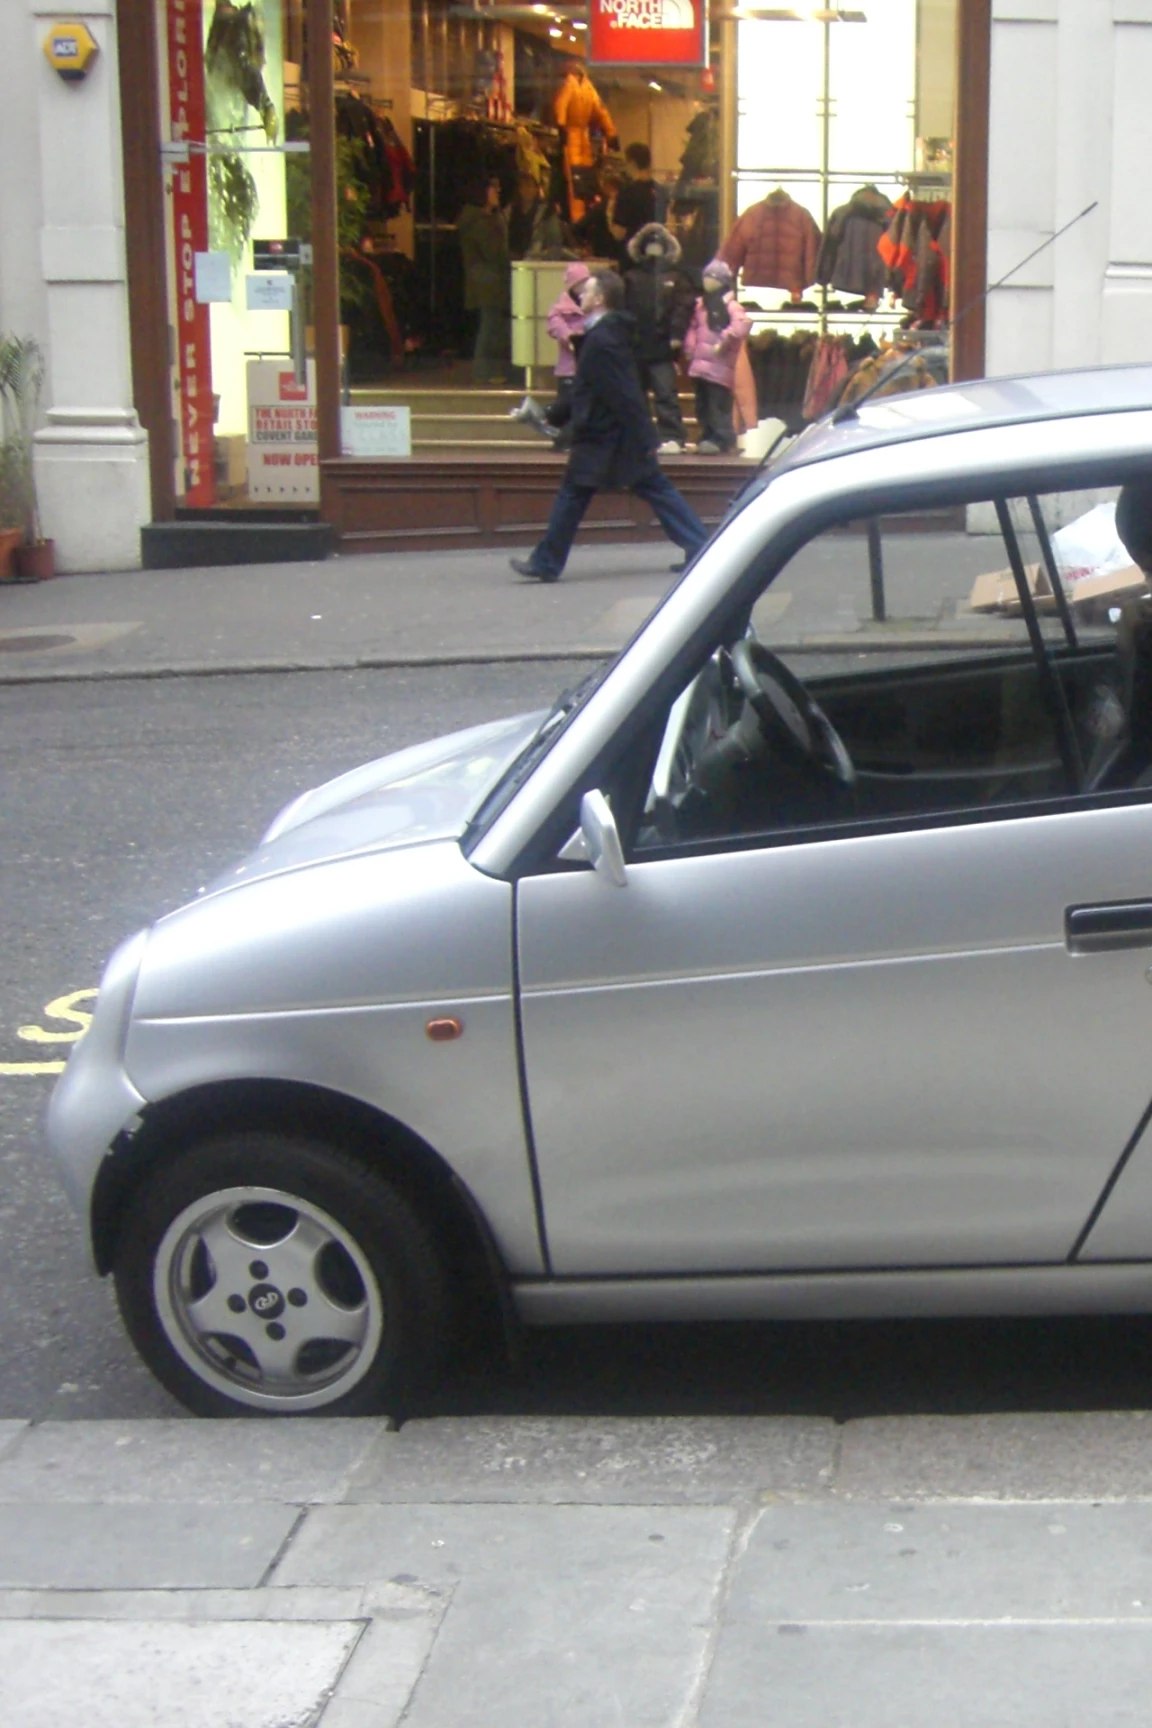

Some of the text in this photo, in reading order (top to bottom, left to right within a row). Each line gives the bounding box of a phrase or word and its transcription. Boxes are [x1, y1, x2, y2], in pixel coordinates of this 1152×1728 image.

[599, 0, 661, 13] NORTH
[617, 13, 662, 29] FACE
[180, 213, 196, 322] STOP
[185, 342, 201, 486] NEVER
[255, 408, 272, 418] THE
[275, 408, 306, 418] NORTH
[354, 411, 397, 420] WARNING
[256, 419, 292, 430] RETAIL
[256, 431, 292, 441] COVENT
[263, 453, 292, 466] NOW
